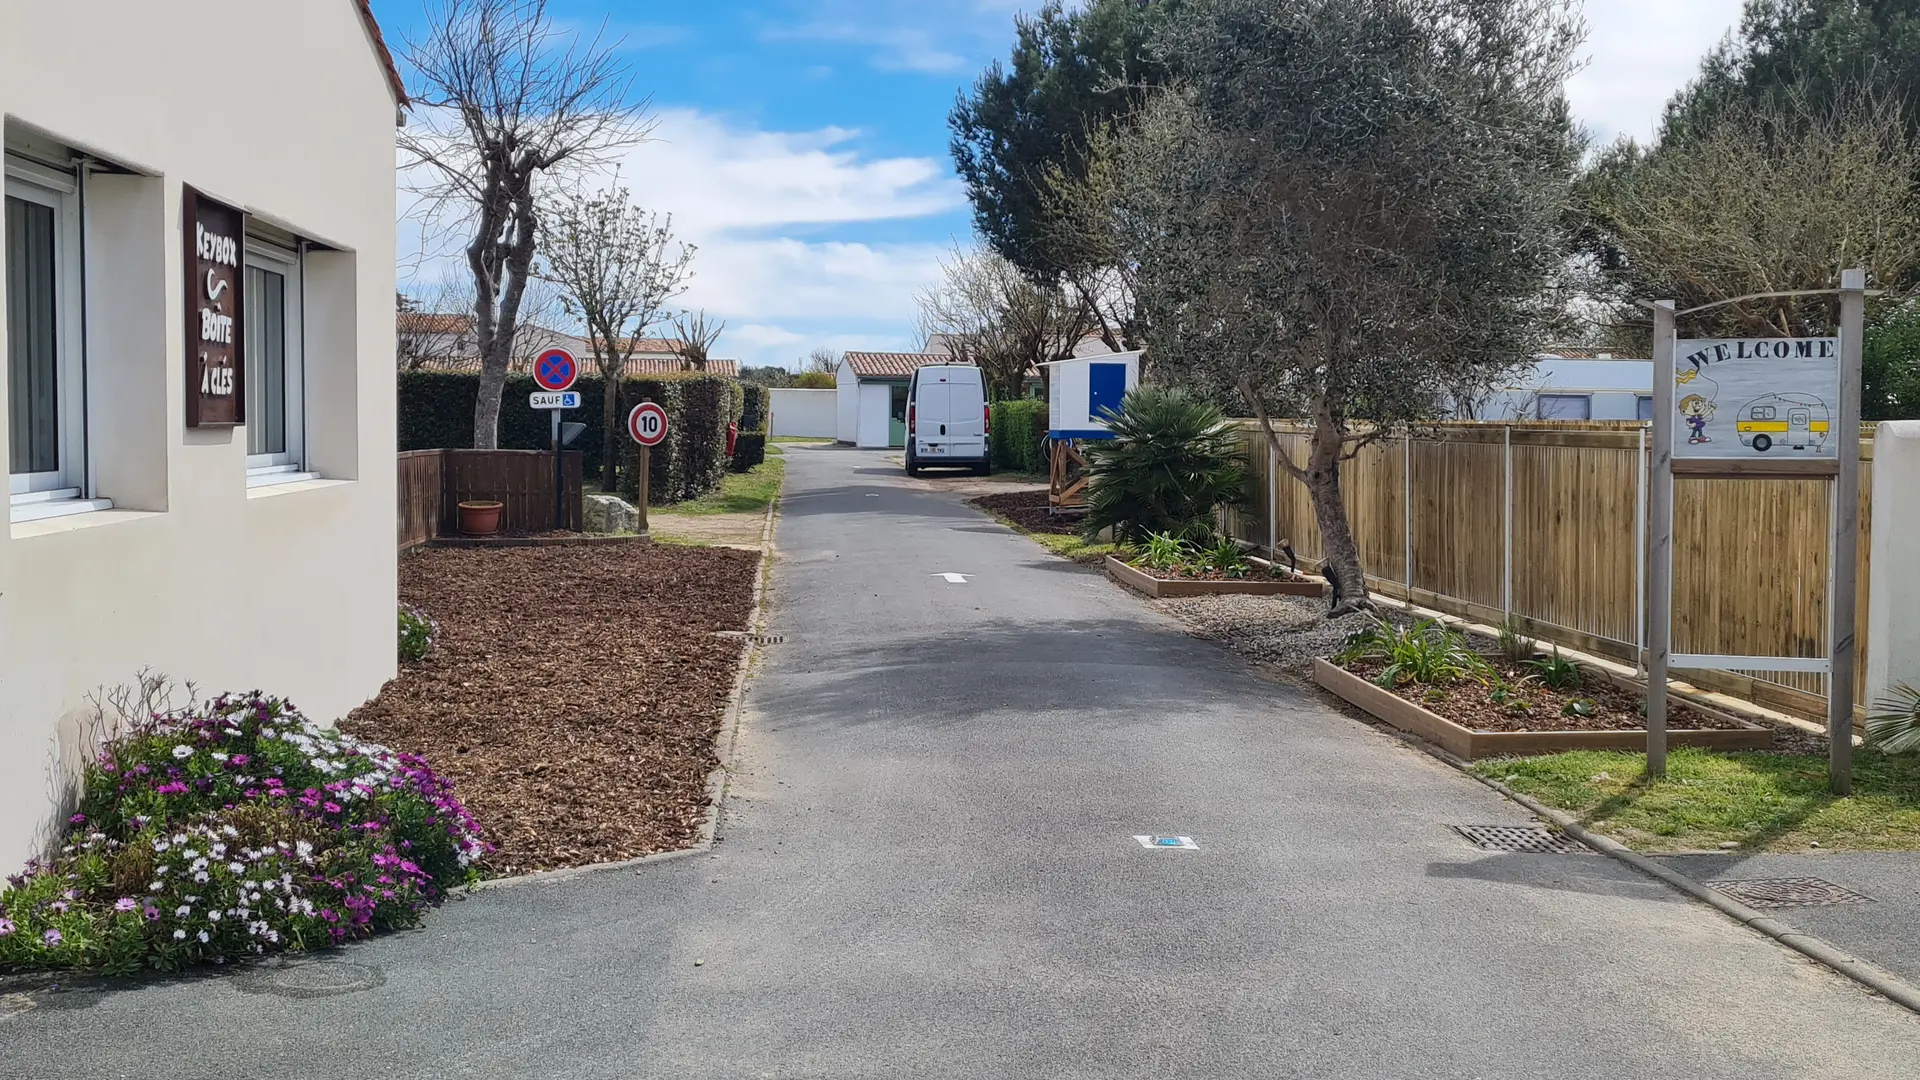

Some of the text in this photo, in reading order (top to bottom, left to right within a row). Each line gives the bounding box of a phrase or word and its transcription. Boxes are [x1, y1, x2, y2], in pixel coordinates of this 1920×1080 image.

[196, 221, 237, 268] KEYBOX
[1687, 340, 1834, 370] WELCOME
[533, 396, 561, 405] SAUF
[641, 416, 658, 432] 10
